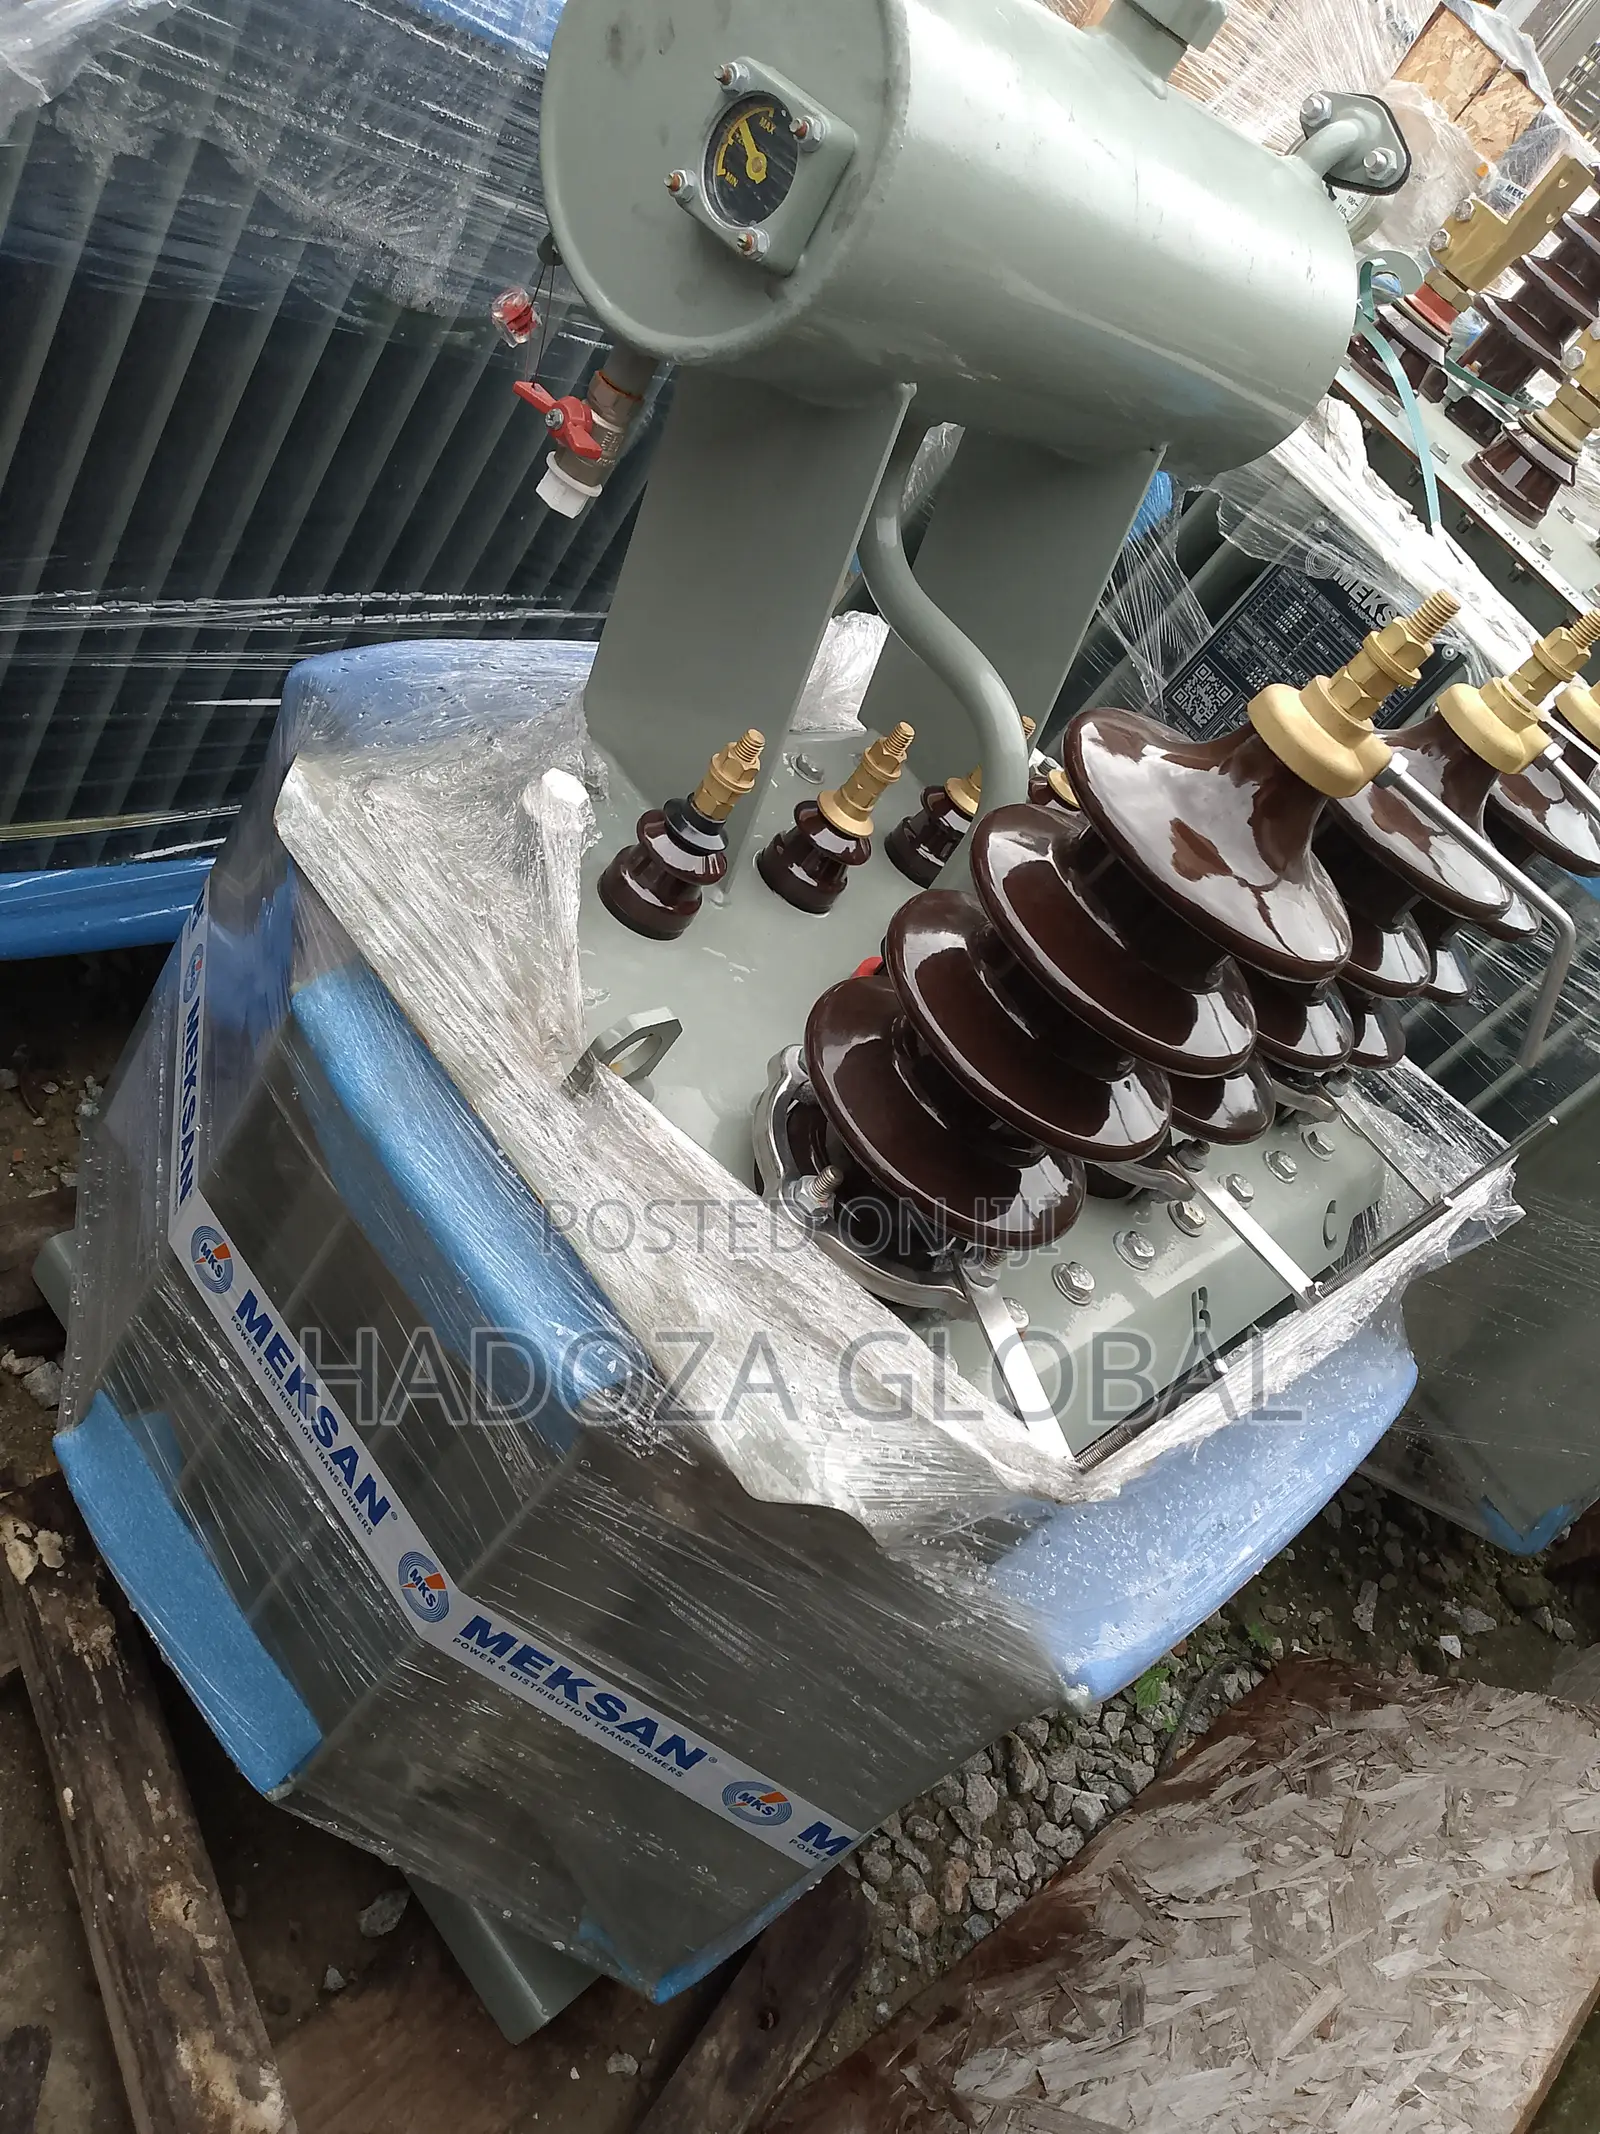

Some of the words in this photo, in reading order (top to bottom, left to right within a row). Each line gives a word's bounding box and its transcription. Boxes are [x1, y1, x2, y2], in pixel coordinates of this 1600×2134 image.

[759, 116, 776, 135] MAX
[724, 172, 739, 188] MIN
[1346, 195, 1356, 206] 100
[1322, 1199, 1338, 1251] C
[200, 1242, 224, 1280] MKS
[231, 1315, 258, 1356] POWER
[256, 1357, 264, 1366] &
[263, 1367, 315, 1445] DISTRIBUTION
[314, 1446, 374, 1536] TRANSFORMERS
[409, 1568, 436, 1608] MKS
[452, 1636, 496, 1666] POWER
[498, 1664, 507, 1673] &
[510, 1671, 592, 1722] DISTRIBUTION
[594, 1720, 684, 1778] TRANSFORMERS
[738, 1792, 776, 1816] MKS
